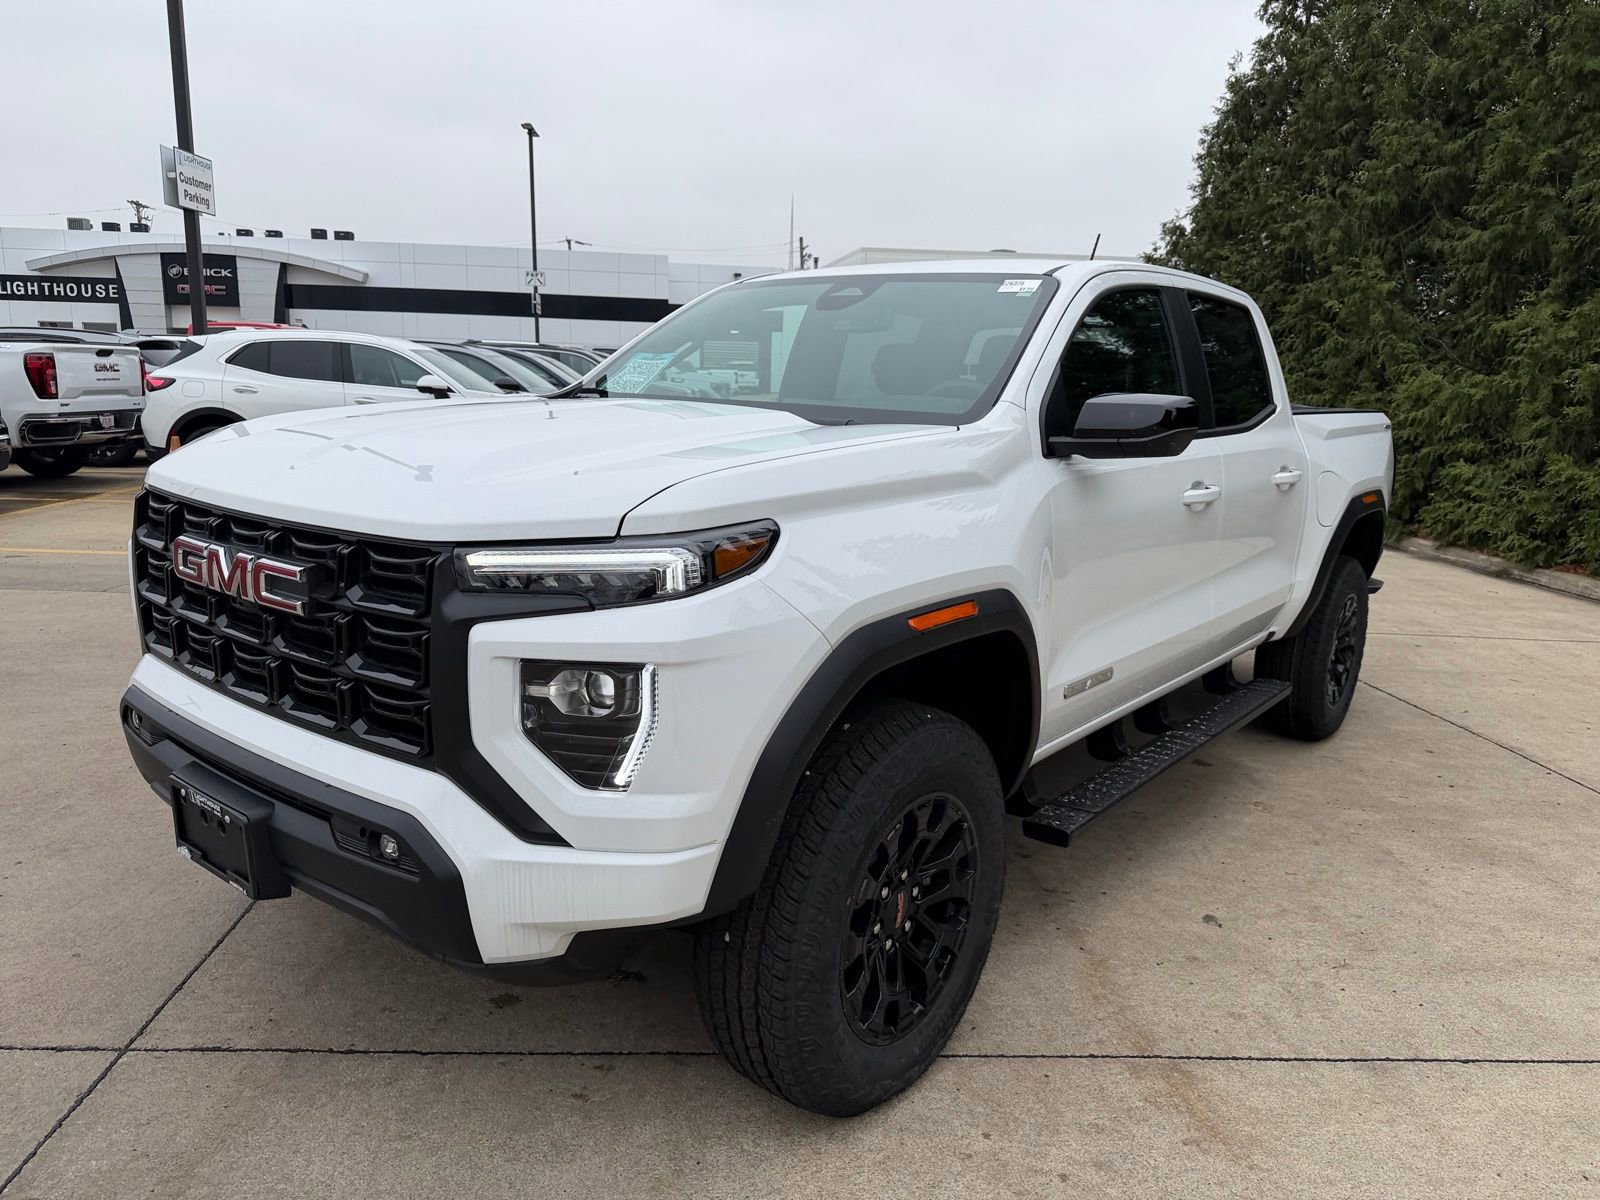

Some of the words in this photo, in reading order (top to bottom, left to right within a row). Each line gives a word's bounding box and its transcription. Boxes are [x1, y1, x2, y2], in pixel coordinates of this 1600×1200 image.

[183, 154, 212, 170] LIGHTHOUSE
[179, 171, 212, 191] Customer
[184, 189, 210, 209] Parking
[0, 281, 119, 298] LIGHTHOUSE
[94, 363, 120, 372] GMC
[173, 535, 305, 617] GMC
